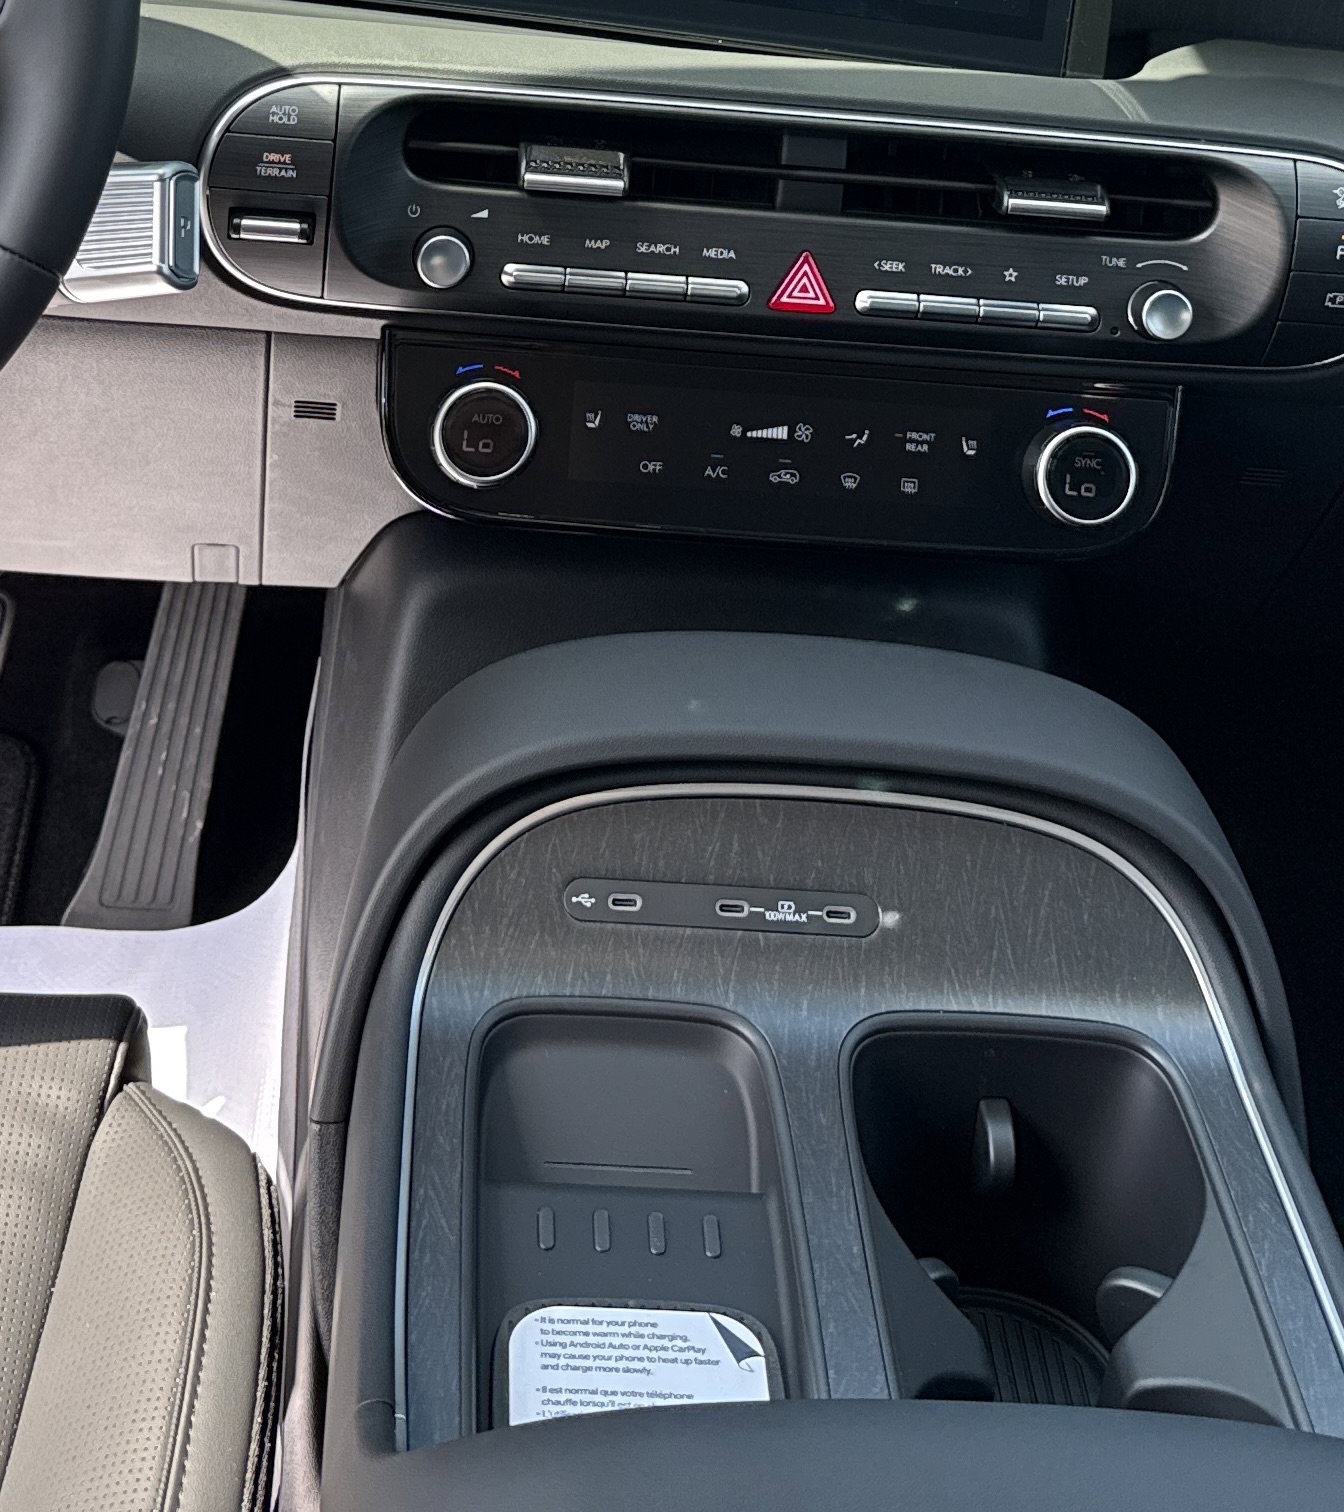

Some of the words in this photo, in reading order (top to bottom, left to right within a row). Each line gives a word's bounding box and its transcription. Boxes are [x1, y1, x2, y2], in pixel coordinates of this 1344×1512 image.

[269, 106, 298, 117] AUTO
[269, 114, 298, 125] HOLD
[262, 152, 292, 164] DRIVE
[256, 166, 297, 179] TERRAIN
[517, 233, 551, 246] HOME
[585, 238, 610, 250] MAP
[636, 241, 680, 256] SEARCH
[702, 247, 736, 260] MEDIA
[1101, 255, 1127, 268] TUNE
[1055, 274, 1089, 287] SETUP
[472, 413, 503, 425] AUTO
[627, 413, 658, 425] DRIVER
[629, 421, 655, 432] ONLY
[906, 431, 935, 442] FRONT
[905, 443, 929, 453] REAR
[639, 461, 664, 474] OFF
[1074, 457, 1102, 469] SYNC
[704, 466, 728, 479] A/C
[785, 912, 807, 922] MAX
[540, 1316, 546, 1324] It
[548, 1316, 555, 1325] is
[557, 1317, 590, 1325] normal
[591, 1318, 604, 1326] for
[604, 1320, 627, 1328] your
[628, 1320, 658, 1328] phone
[551, 1328, 590, 1337] become
[620, 1331, 646, 1339] while
[647, 1332, 690, 1343] charging.
[540, 1339, 567, 1349] Using
[568, 1340, 606, 1349] Android
[607, 1342, 630, 1350] Auto
[642, 1343, 670, 1353] Apple
[671, 1344, 706, 1355] CarPlay
[540, 1352, 561, 1360] may
[592, 1354, 613, 1362] your
[615, 1354, 645, 1363] phone
[646, 1355, 656, 1363] to
[658, 1355, 678, 1364] heat
[680, 1358, 693, 1366] up
[694, 1357, 721, 1366] faster
[540, 1363, 559, 1371] and
[561, 1363, 593, 1373] charge
[595, 1366, 620, 1374] more
[548, 1387, 562, 1395] est
[564, 1387, 598, 1395] normal
[600, 1389, 618, 1398] que
[620, 1390, 644, 1398] votre
[646, 1389, 694, 1400] téléphone
[541, 1398, 579, 1407] chauffe
